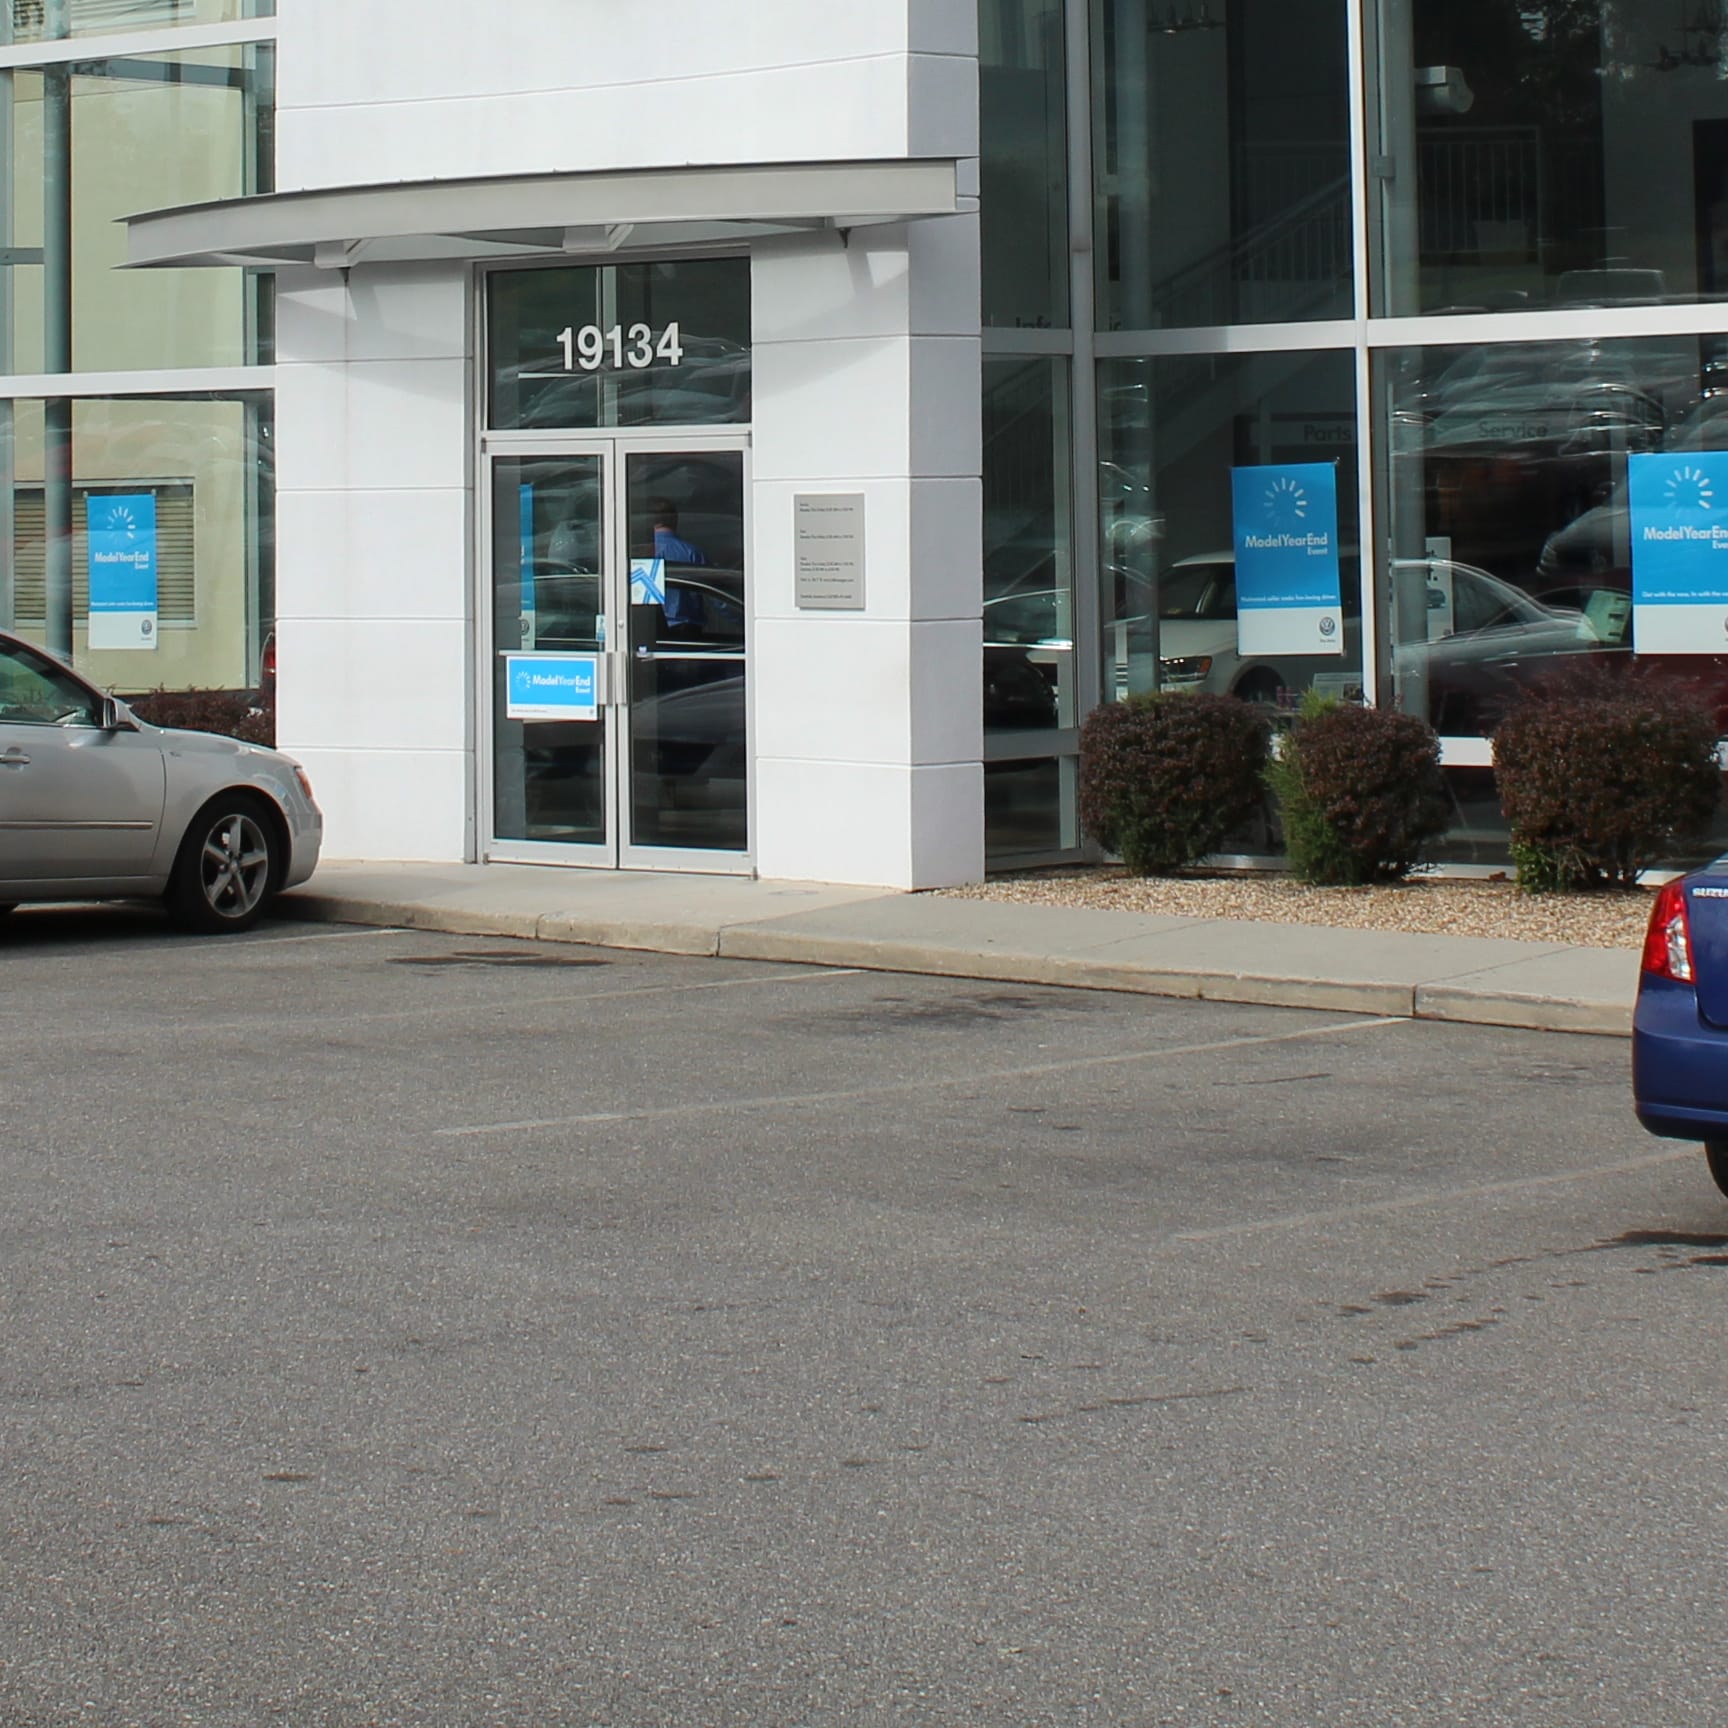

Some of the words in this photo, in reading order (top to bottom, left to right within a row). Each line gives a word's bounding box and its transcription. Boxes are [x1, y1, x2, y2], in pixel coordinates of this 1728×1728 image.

[556, 321, 683, 370] 19134
[1303, 425, 1351, 442] Parts
[1479, 420, 1548, 438] Service
[1307, 547, 1328, 556] Event
